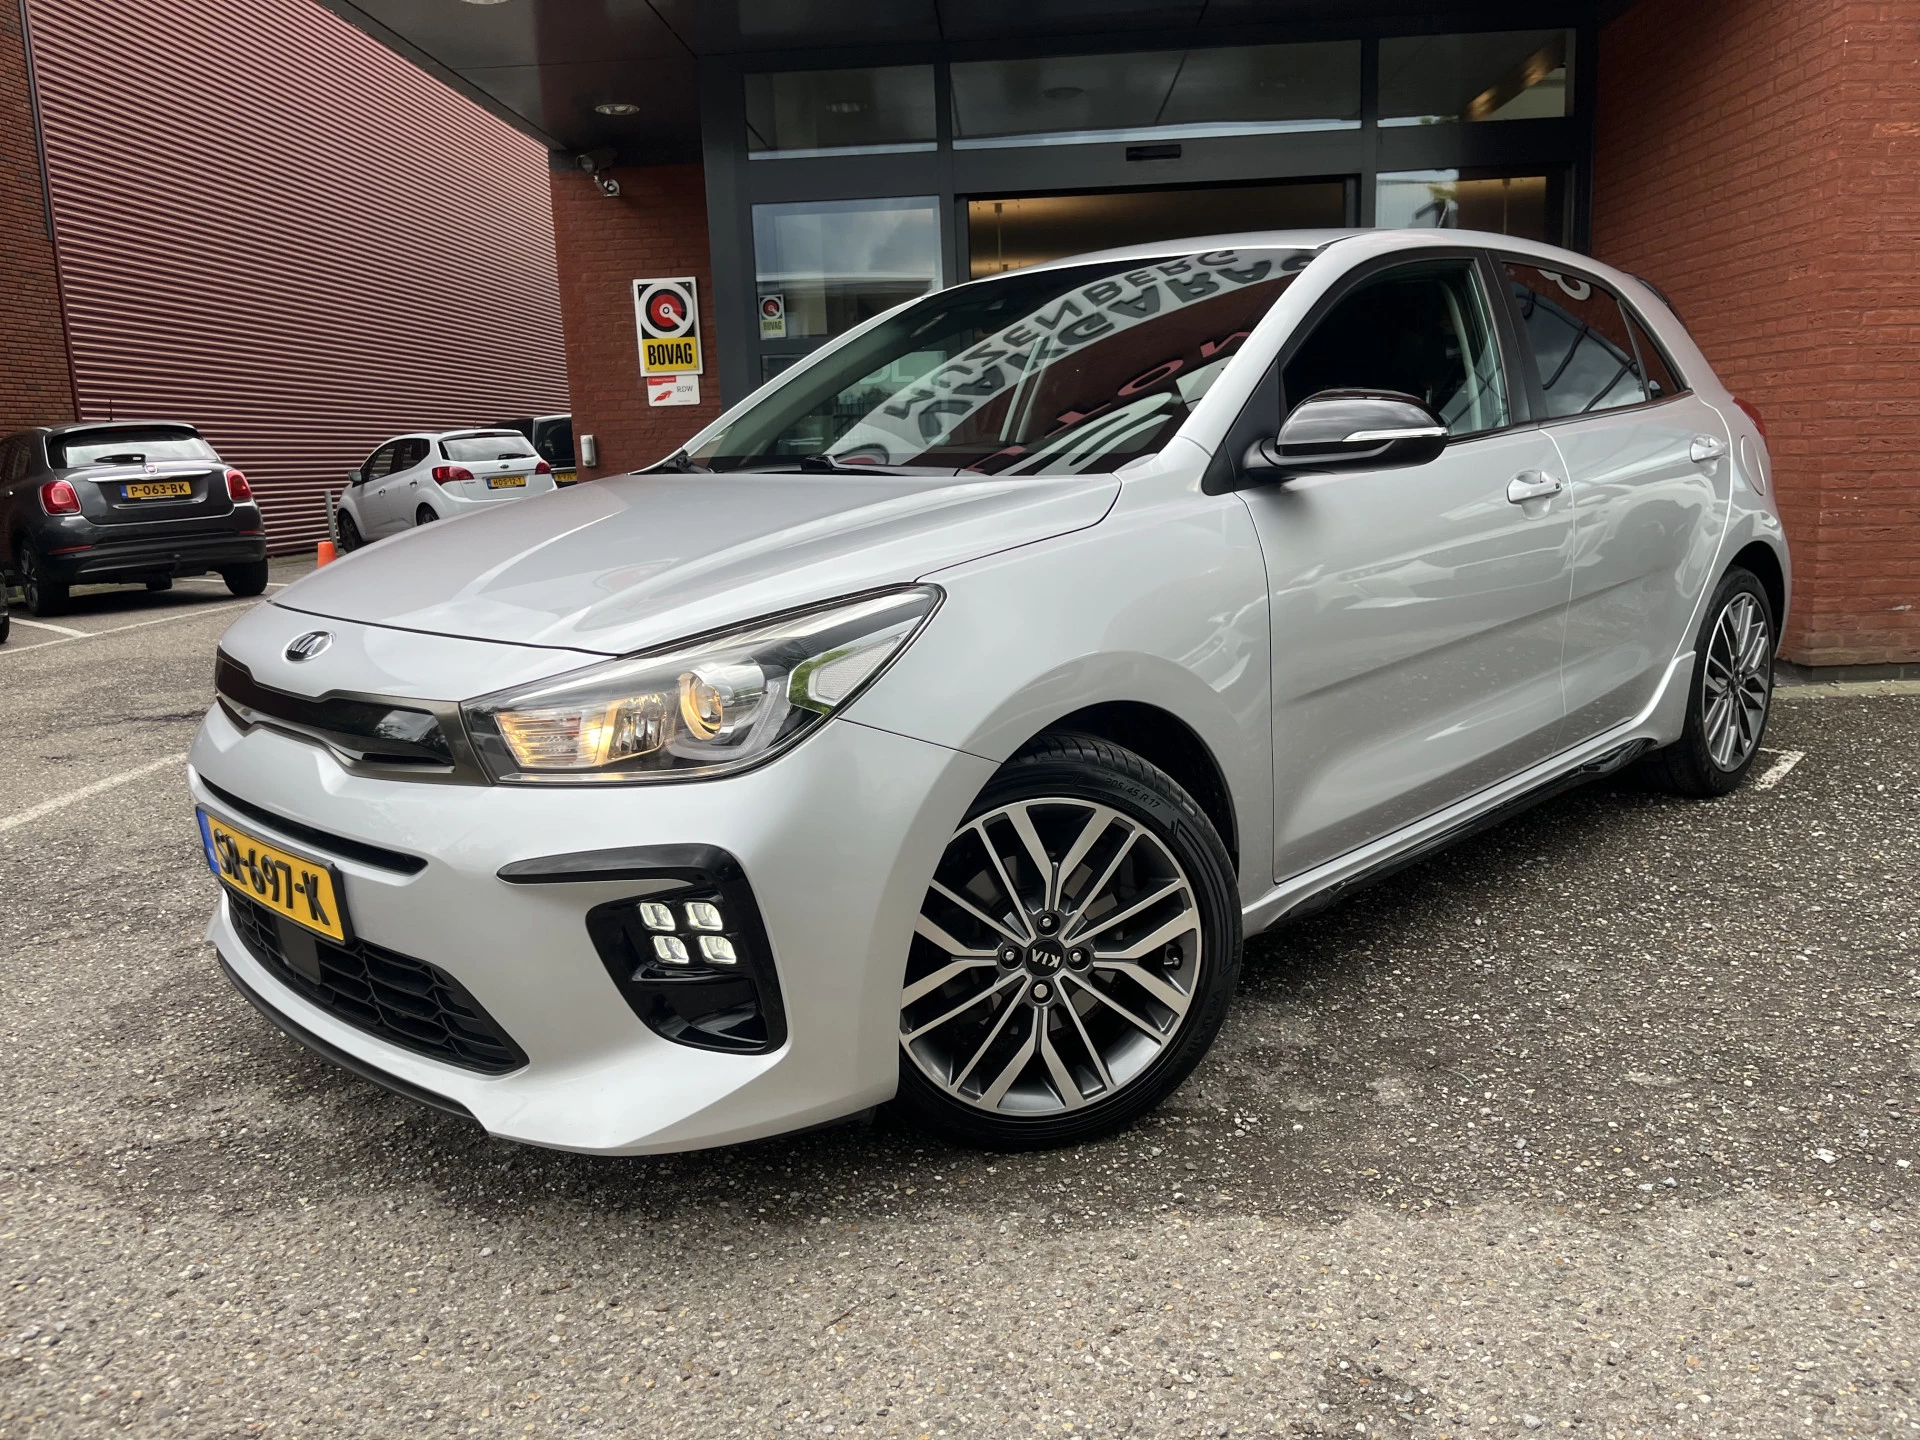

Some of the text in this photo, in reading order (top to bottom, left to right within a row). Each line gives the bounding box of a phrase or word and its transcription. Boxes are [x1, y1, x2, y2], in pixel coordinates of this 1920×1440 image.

[647, 342, 693, 366] BOVAG
[676, 385, 693, 393] RDW
[130, 483, 186, 496] P-063-BK
[1104, 777, 1139, 797] 205/45
[214, 828, 330, 926] SR-697-K
[1032, 948, 1061, 968] KIA
